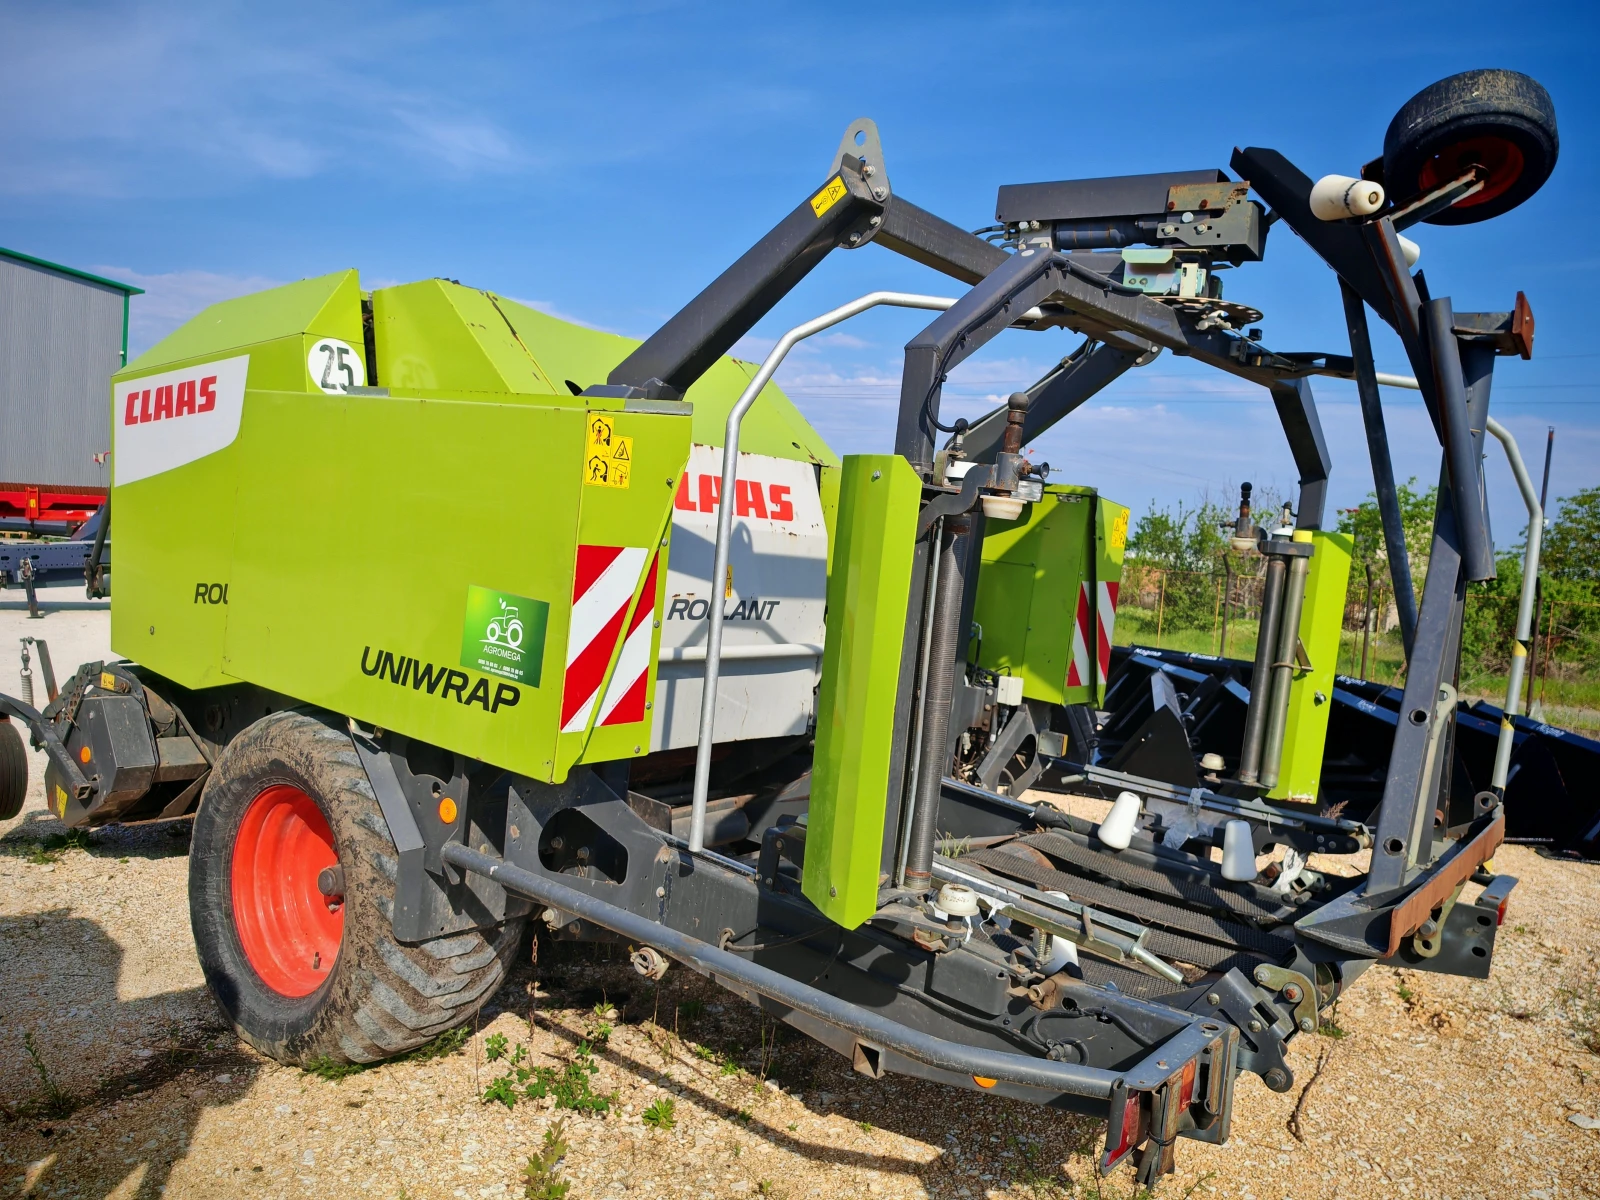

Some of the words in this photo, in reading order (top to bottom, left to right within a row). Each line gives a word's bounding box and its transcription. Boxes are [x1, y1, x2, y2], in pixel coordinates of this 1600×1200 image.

[319, 344, 354, 392] 25
[124, 375, 217, 426] CLAAS
[674, 471, 793, 521] LAAS
[483, 644, 521, 662] AGROMEGA
[360, 646, 521, 714] UNIWRAP
